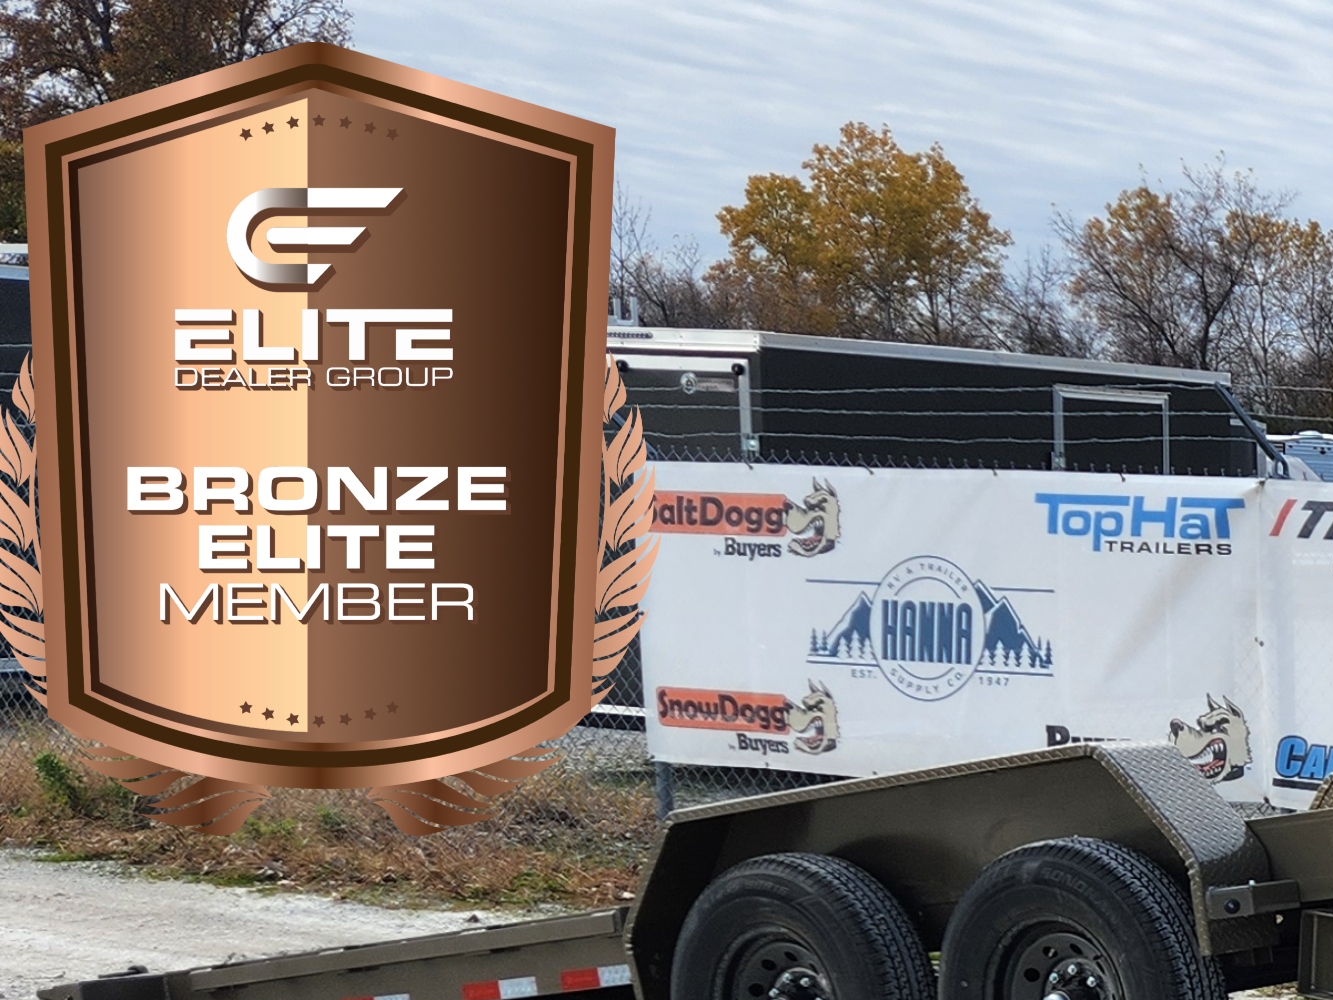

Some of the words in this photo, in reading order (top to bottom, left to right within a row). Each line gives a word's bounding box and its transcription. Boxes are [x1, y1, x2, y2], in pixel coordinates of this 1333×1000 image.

[724, 537, 782, 561] Buyers
[1105, 540, 1232, 556] TRAILERS
[887, 575, 900, 590] RV
[918, 563, 969, 593] TRAILER
[881, 599, 972, 665] HANNA
[851, 670, 878, 679] EST.
[889, 668, 941, 695] SUPPLY
[978, 676, 1010, 687] 1947
[657, 688, 787, 732] SnowDogg
[737, 733, 790, 756] Buyers
